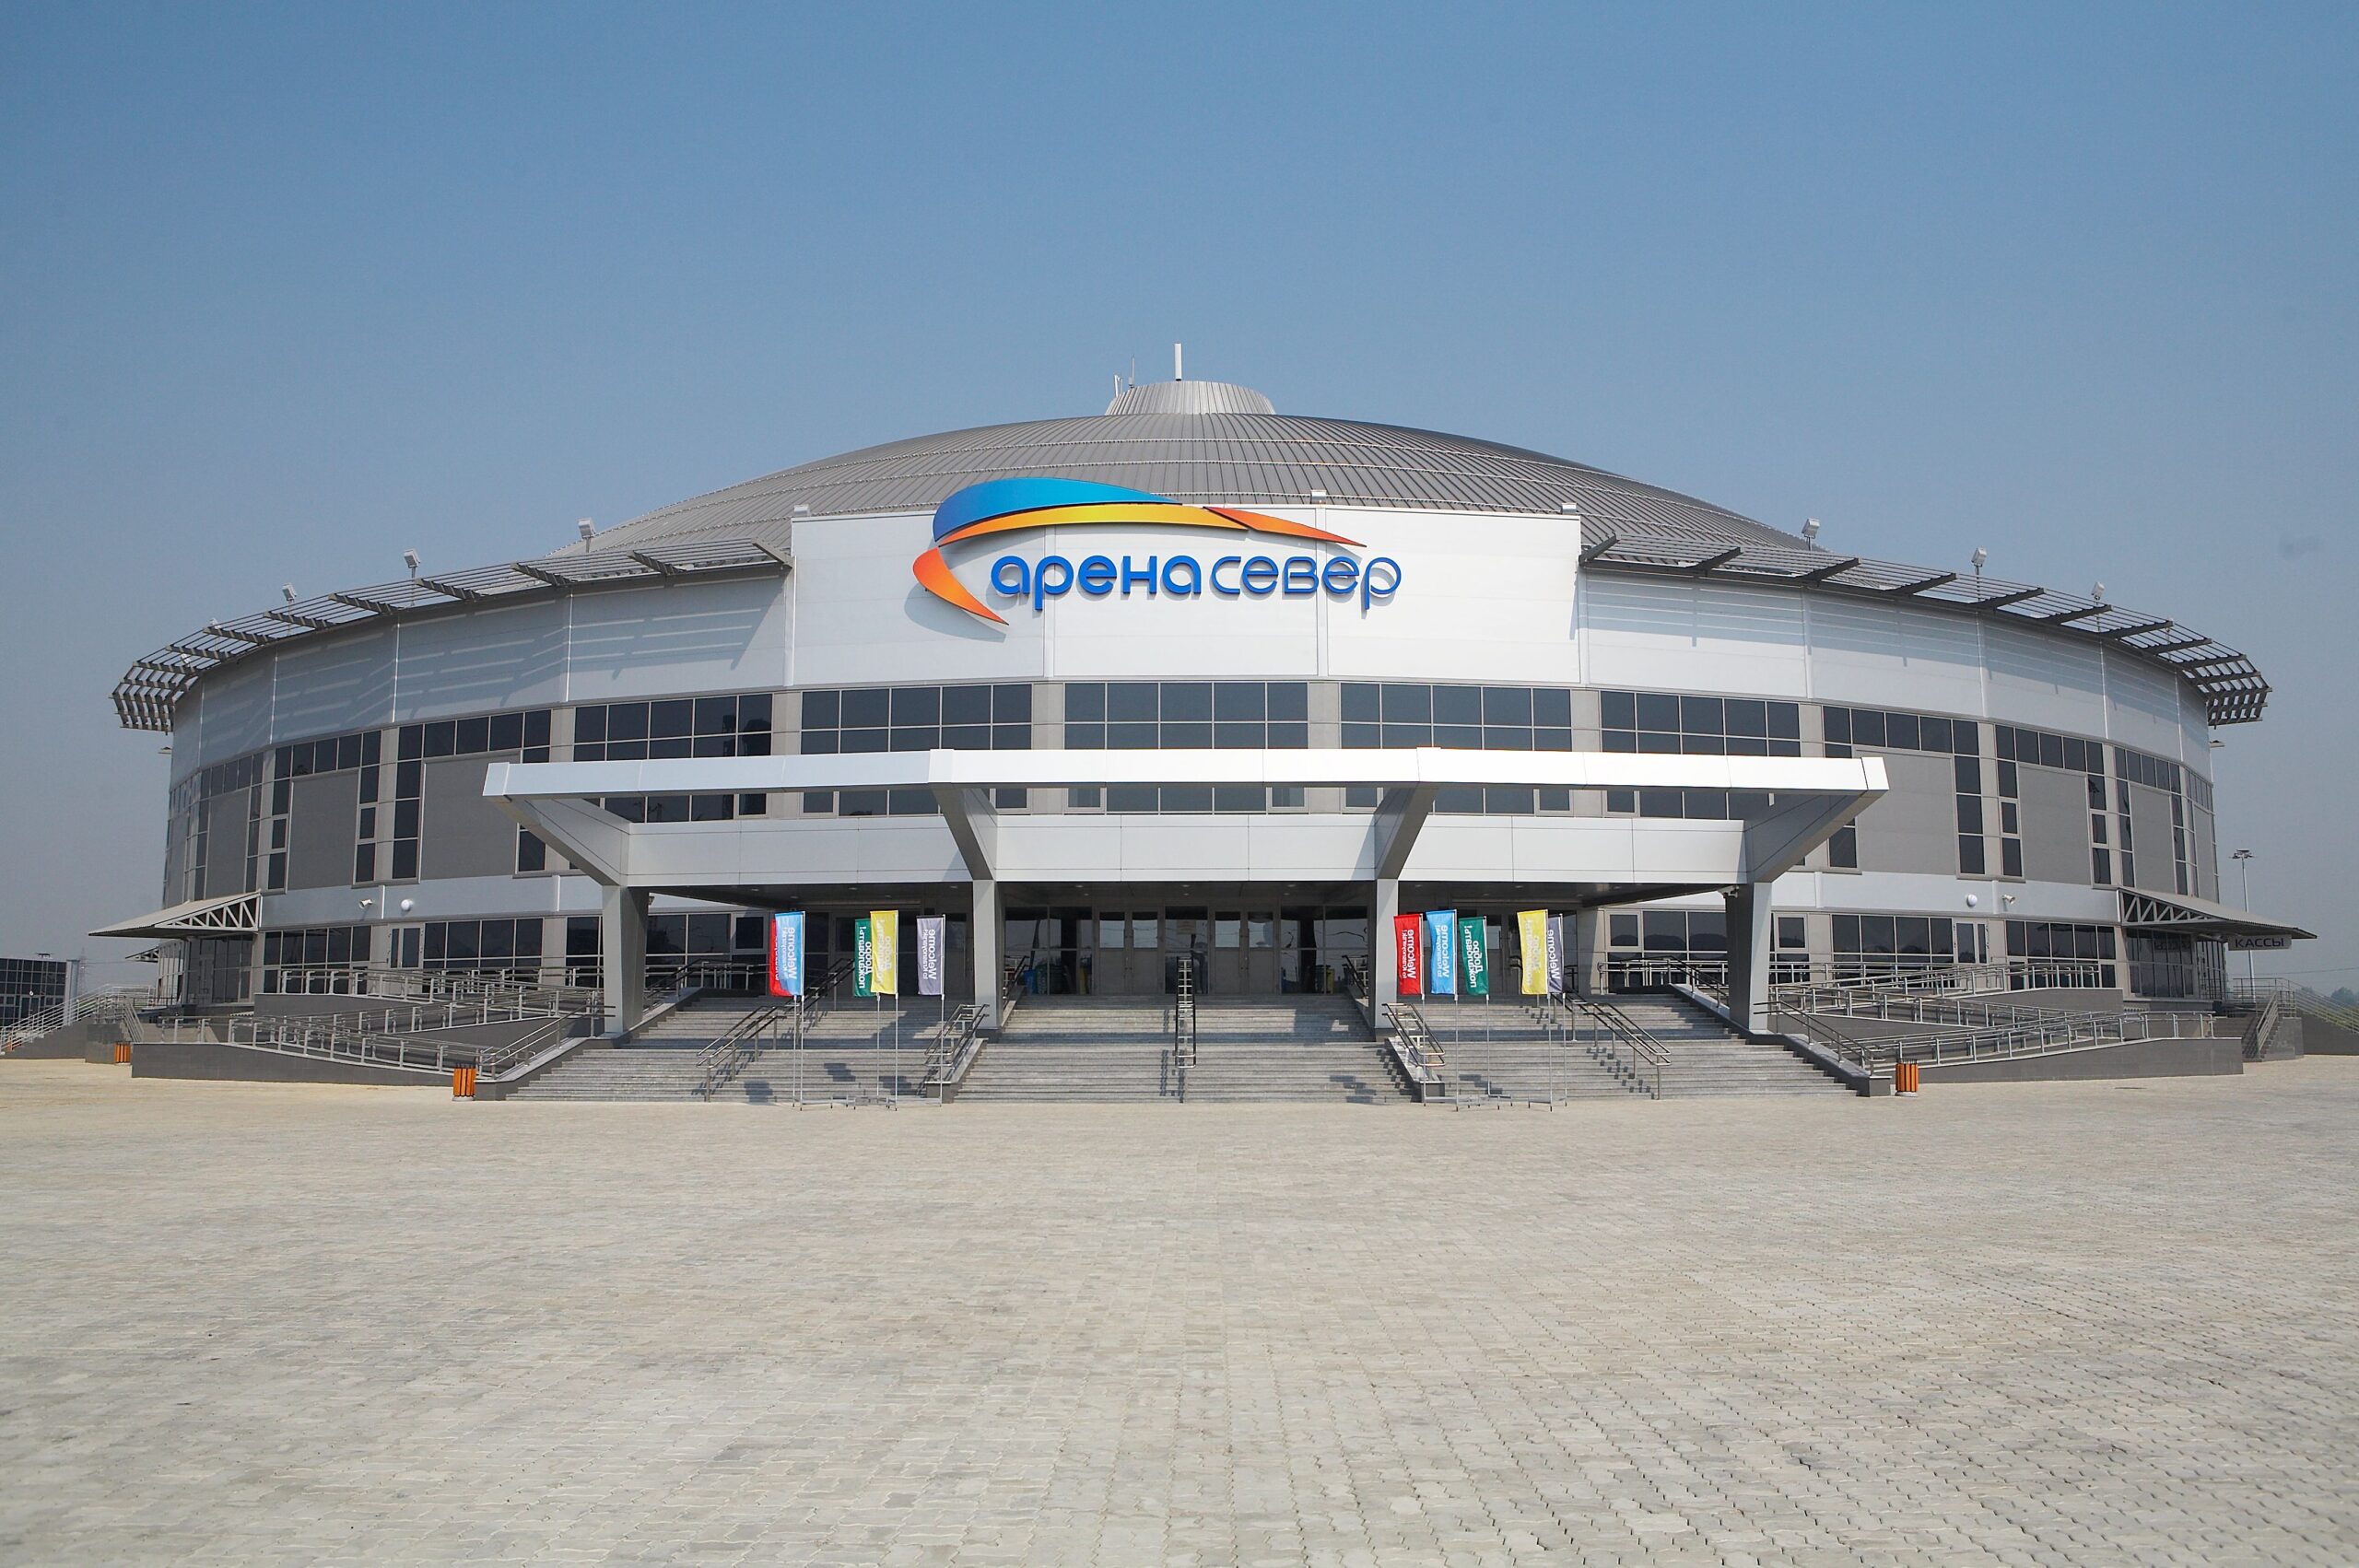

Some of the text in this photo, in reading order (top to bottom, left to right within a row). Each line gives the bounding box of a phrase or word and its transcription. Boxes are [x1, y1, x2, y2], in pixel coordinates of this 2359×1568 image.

[991, 555, 1402, 611] арена север
[2236, 937, 2283, 948] КАССЫ
